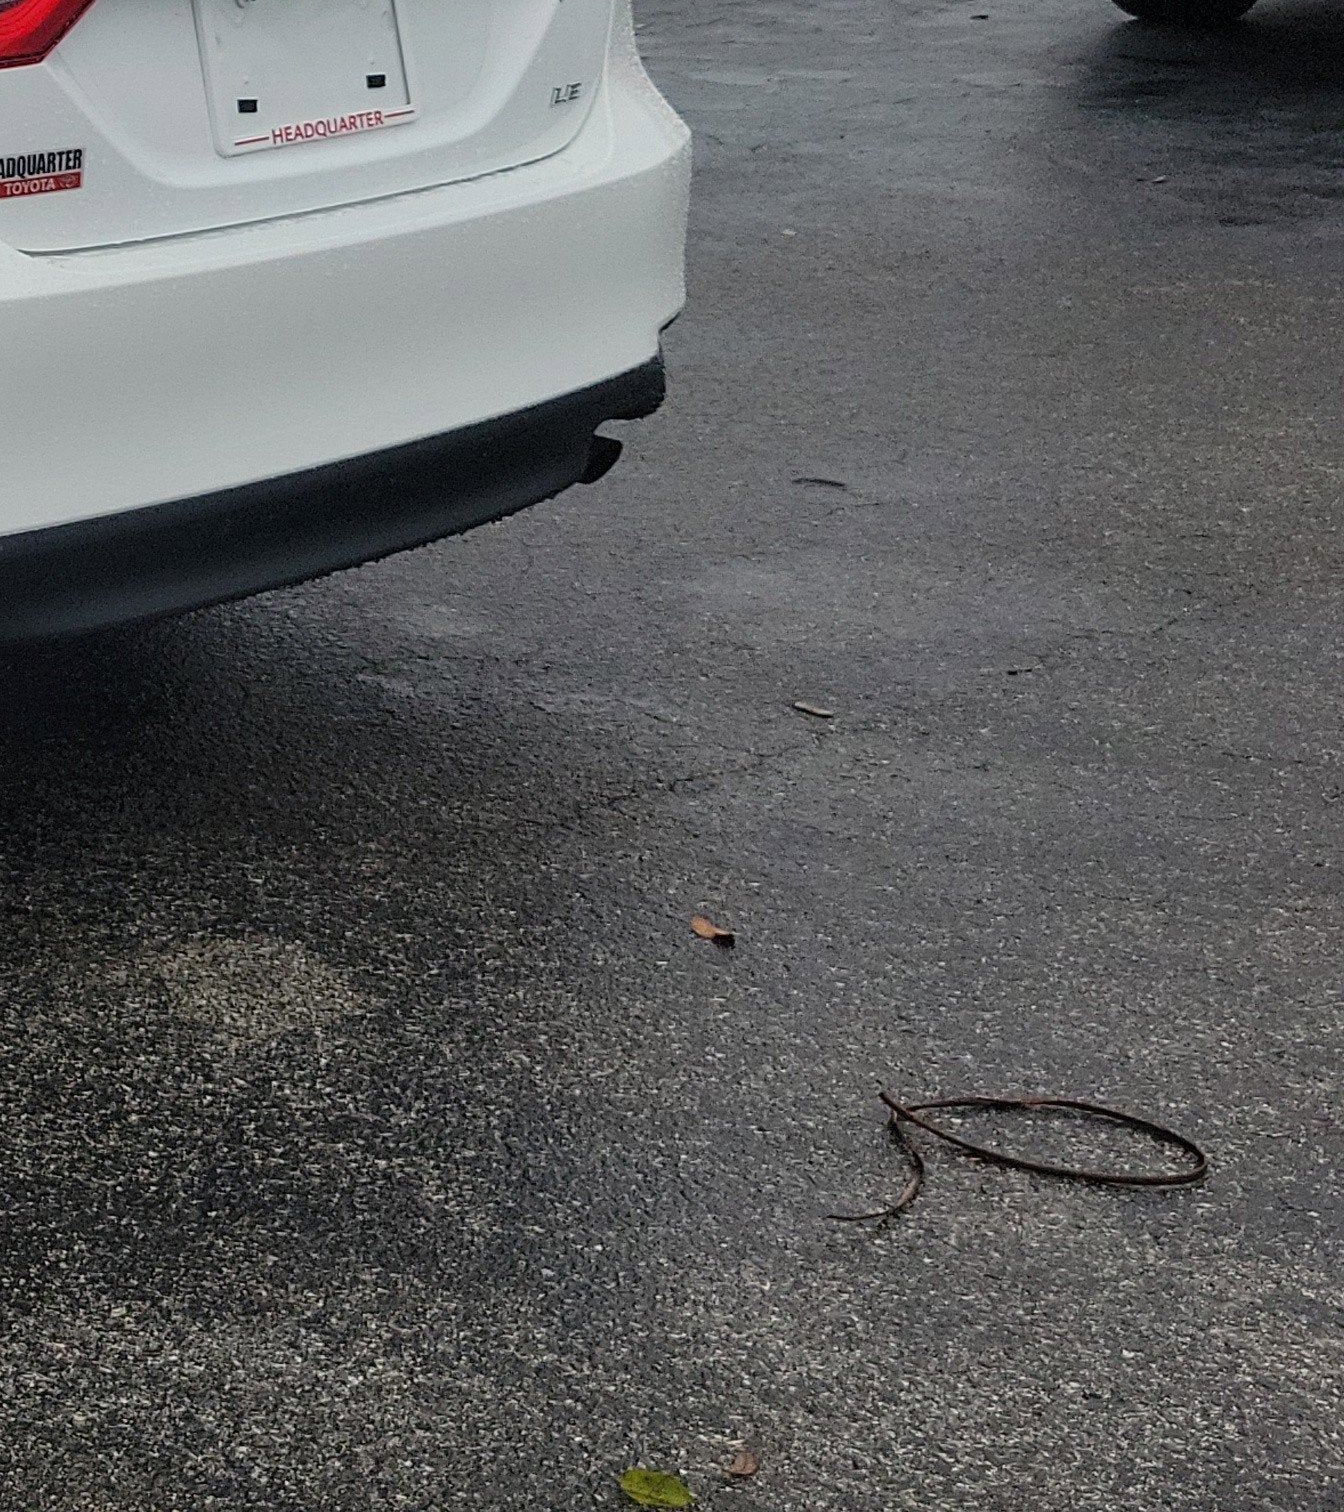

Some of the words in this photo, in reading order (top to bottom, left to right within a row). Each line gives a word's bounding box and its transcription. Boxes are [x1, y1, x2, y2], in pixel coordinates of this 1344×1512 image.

[551, 82, 582, 108] LE
[271, 110, 384, 144] HEADQUARTER
[4, 178, 55, 195] TOYOTA
